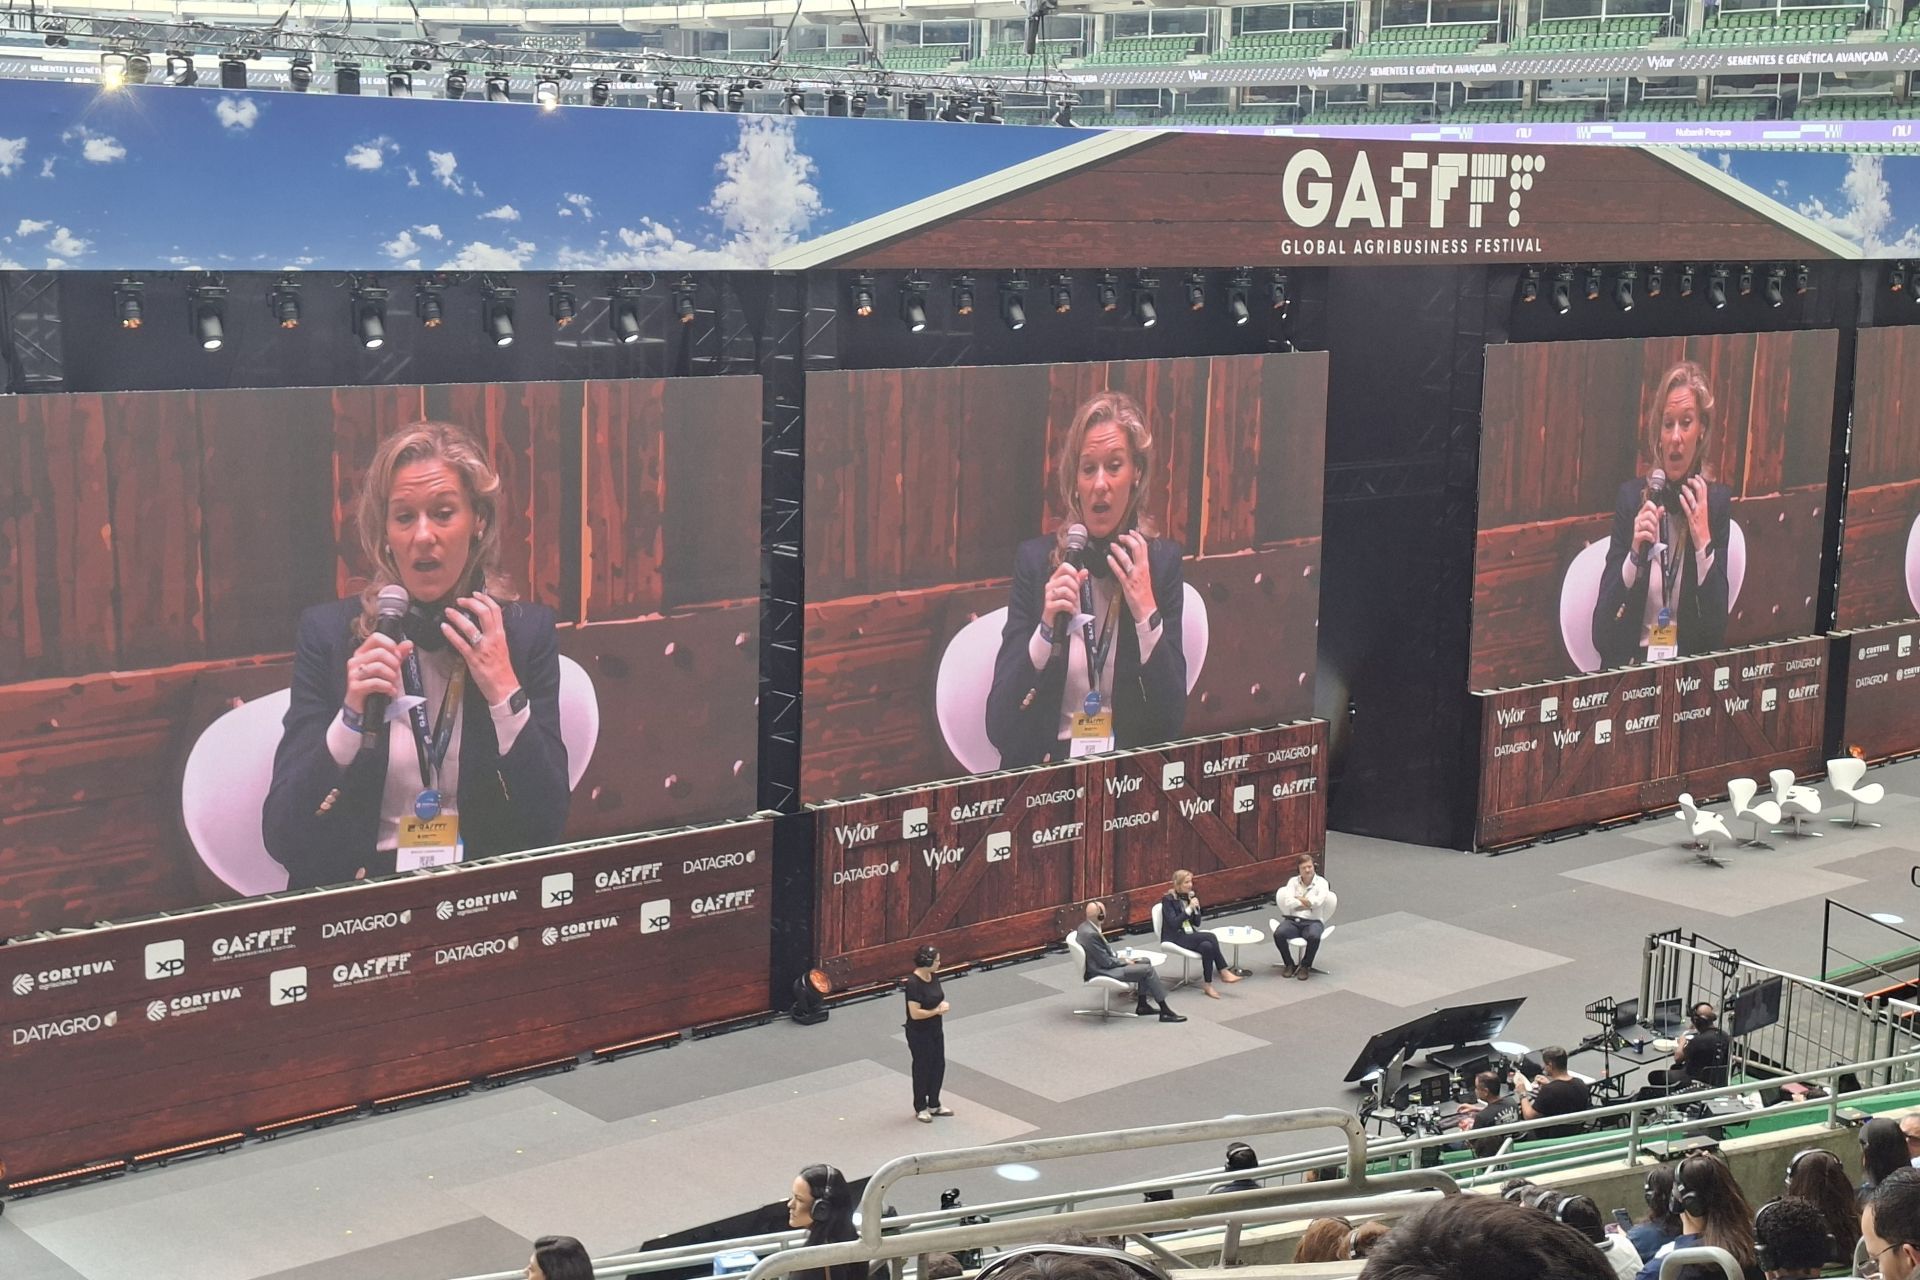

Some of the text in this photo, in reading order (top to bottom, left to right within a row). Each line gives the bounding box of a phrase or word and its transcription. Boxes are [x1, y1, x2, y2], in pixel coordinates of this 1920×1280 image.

[1727, 51, 1888, 66] SEMENTES E GENÉTICA AVANÇADA
[1370, 63, 1497, 76] SEMENTES E GENÉTICA AVANÇADA
[1704, 127, 1732, 138] Parque
[1281, 237, 1542, 255] GLOBAL AGRIBUSINESS FESTIVAL
[1622, 687, 1655, 701] DATAGRO
[1676, 676, 1701, 696] Vylor
[1673, 708, 1705, 723] DATAGRO
[1725, 696, 1749, 716] Vylor
[1497, 707, 1525, 728] Vylor
[1494, 741, 1531, 757] DATAGRO
[1553, 728, 1580, 749] Vylor
[1268, 746, 1311, 764] DATAGRO
[1106, 775, 1143, 799] Vylor
[1026, 789, 1076, 808] DATAGRO
[1180, 797, 1215, 820] Vylor
[1104, 812, 1151, 832] DATAGRO
[835, 823, 879, 848] Vylor
[683, 852, 744, 874] DATAGRO
[922, 845, 965, 871] Vylor
[833, 863, 889, 885] DATAGRO
[456, 890, 517, 910] CORTEVA
[322, 912, 398, 939] DATAGRO
[561, 916, 618, 936] CORTEVA
[212, 926, 296, 956] GAFFFF
[435, 938, 506, 965] DATAGRO
[38, 960, 114, 983] CORTEVA
[333, 952, 412, 982] GAFFFF
[170, 987, 242, 1010] CORTEVA
[13, 1014, 101, 1045] DATAGRO
